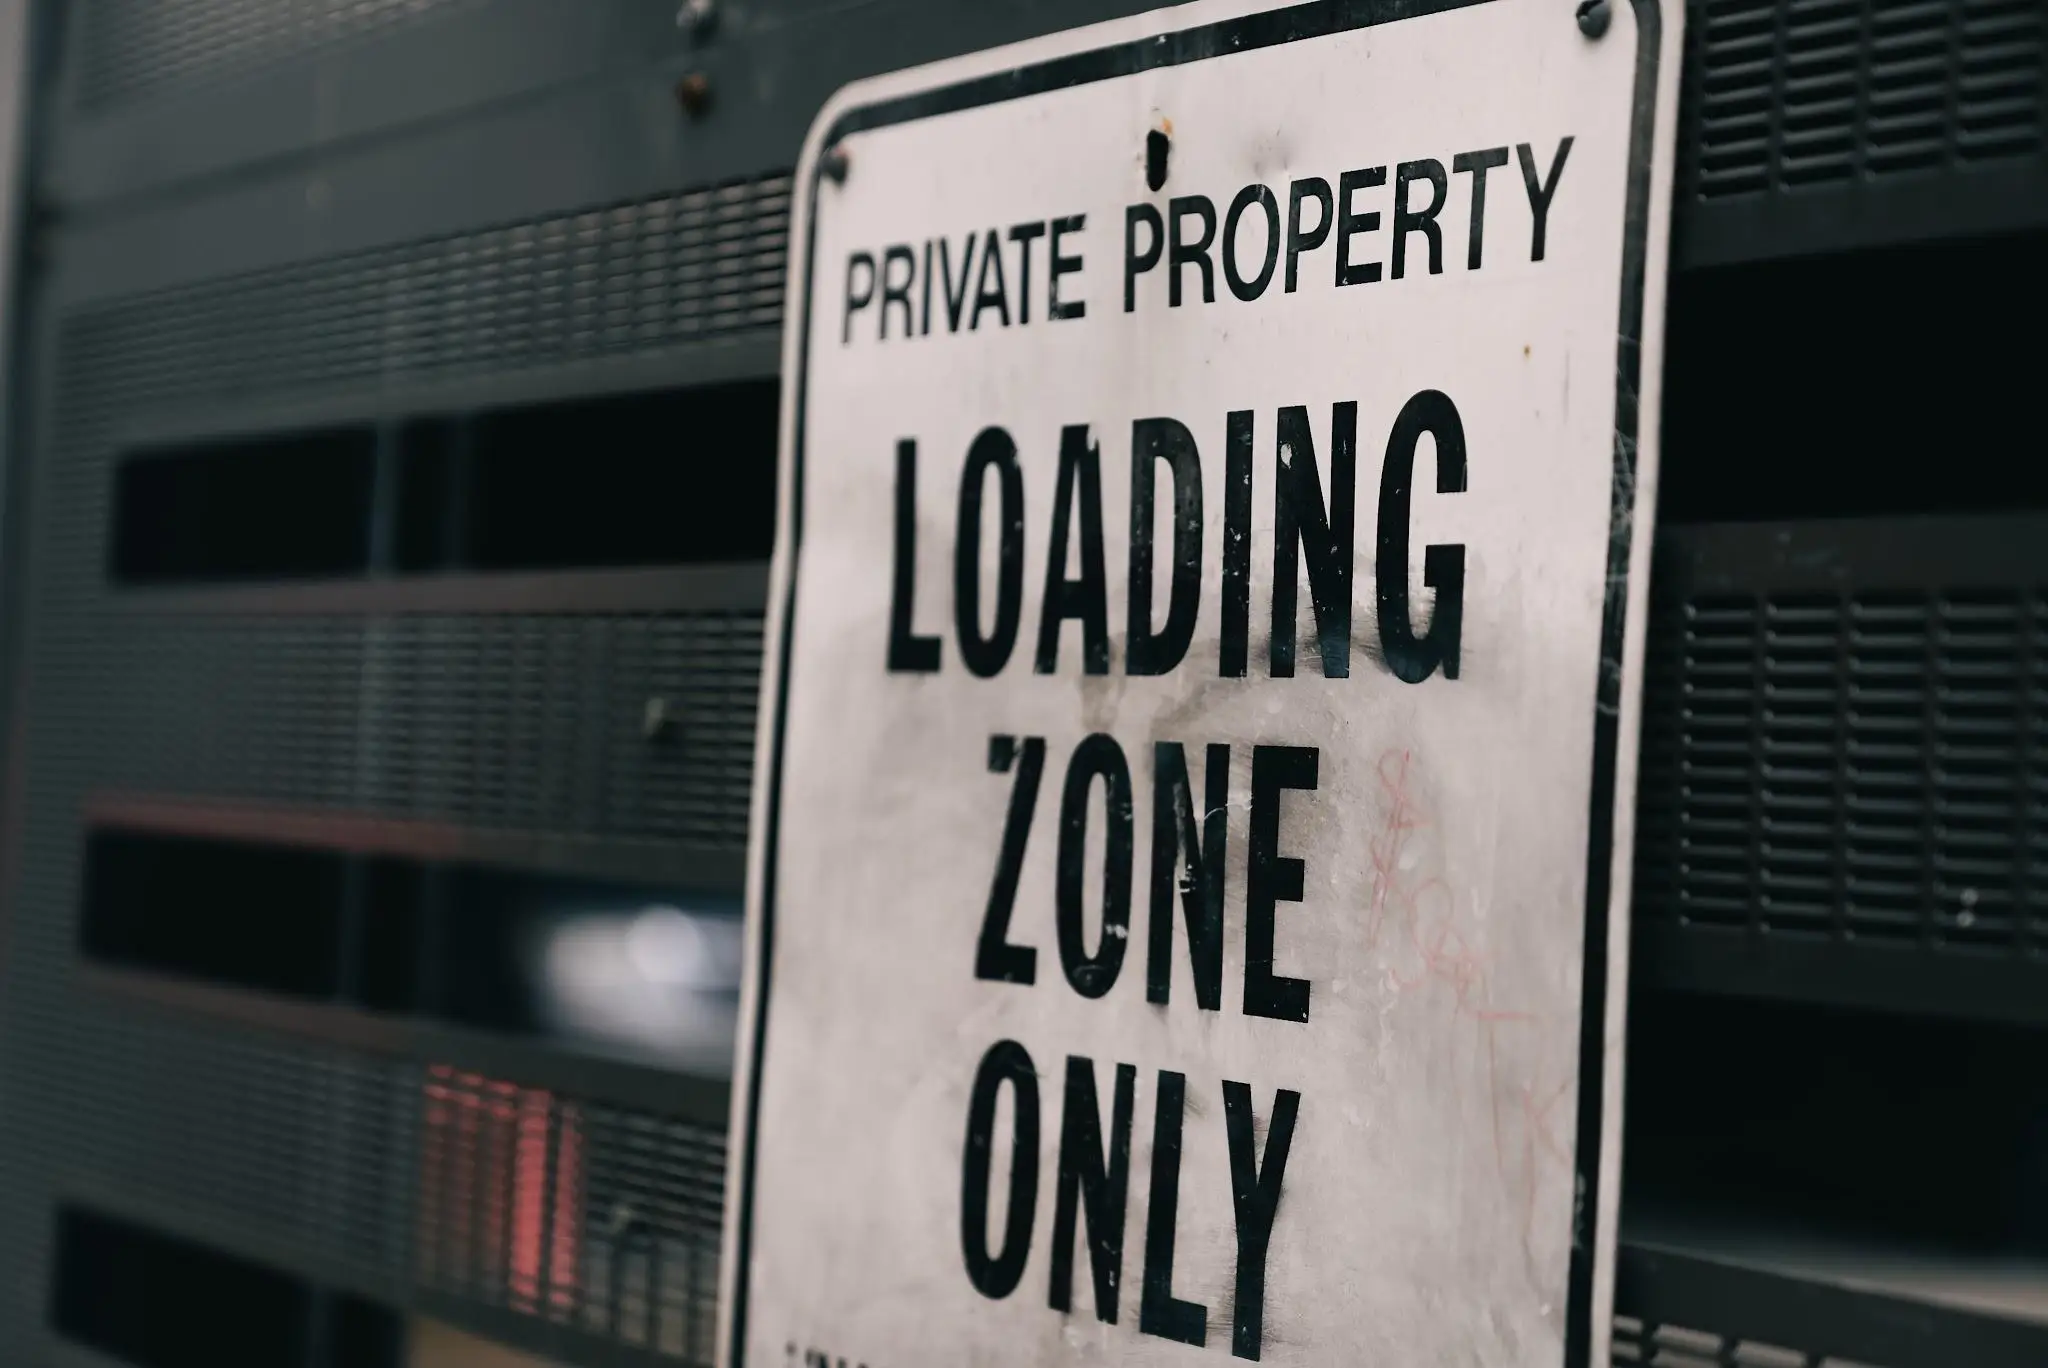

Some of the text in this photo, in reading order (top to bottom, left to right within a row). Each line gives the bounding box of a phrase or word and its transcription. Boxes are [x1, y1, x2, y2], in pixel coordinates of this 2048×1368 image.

[842, 136, 1575, 344] PRIVATE PROPERTY
[886, 389, 1469, 684] LOADING
[974, 732, 1320, 1024] ZONE
[961, 1039, 1302, 1362] ONLY
